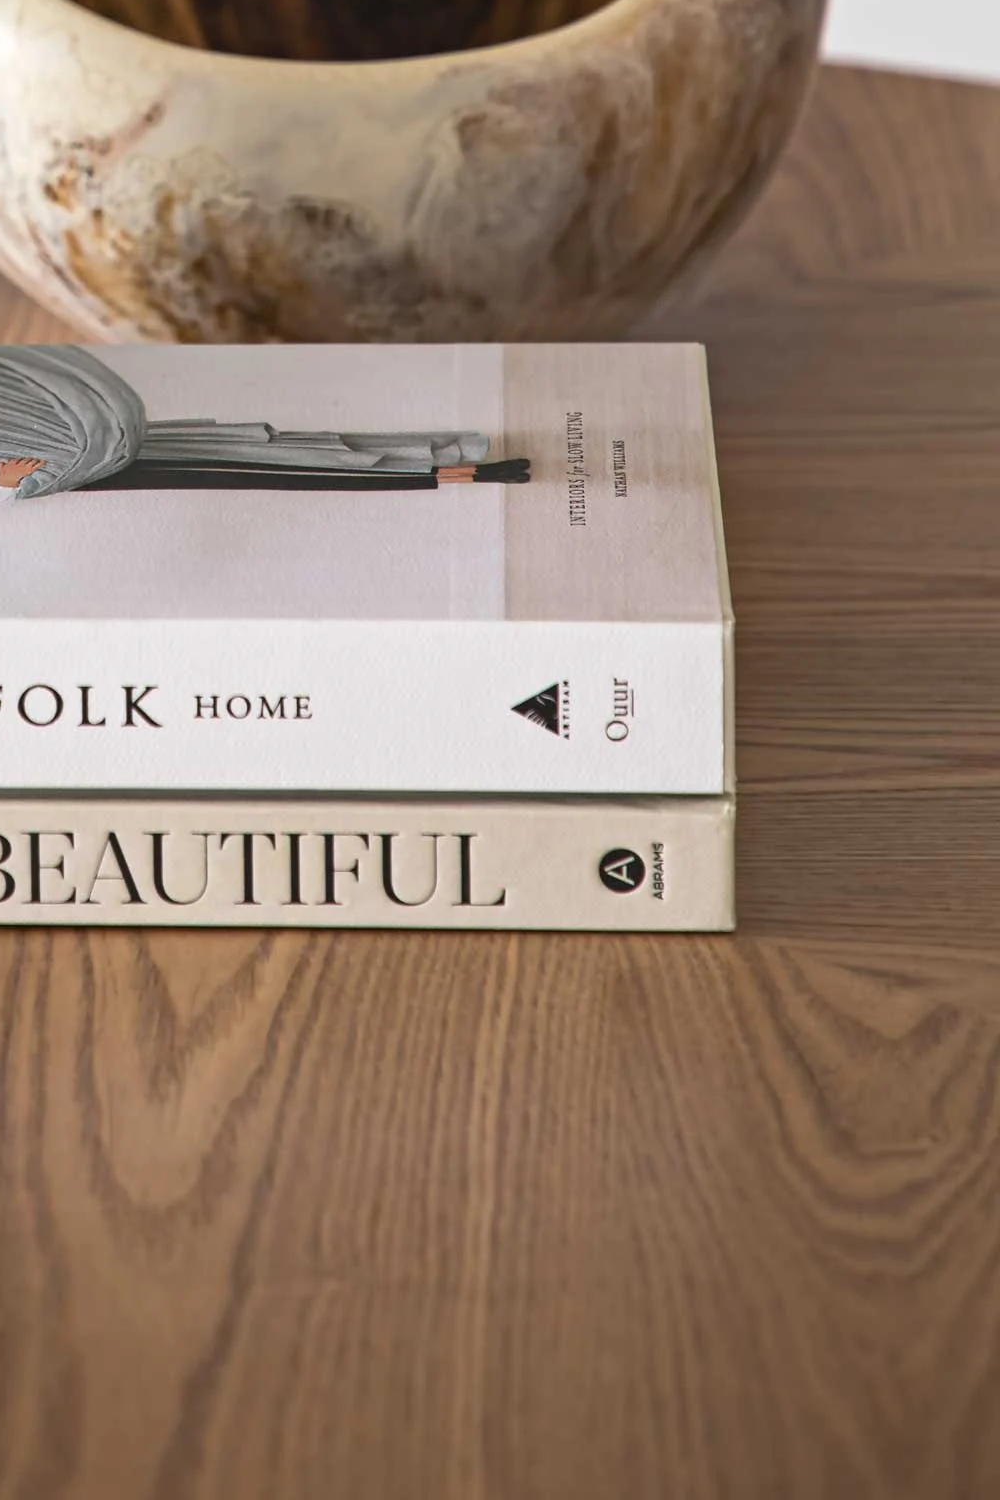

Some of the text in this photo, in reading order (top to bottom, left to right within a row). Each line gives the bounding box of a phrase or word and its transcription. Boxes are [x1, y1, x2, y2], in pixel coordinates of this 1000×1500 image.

[566, 411, 590, 526] INTERIORS for SLOW LIVING
[612, 440, 627, 498] NATHAN WILLIAMS
[193, 694, 313, 721] HOME
[562, 679, 570, 740] ARTISAN
[604, 677, 630, 743] Ouur
[652, 841, 665, 901] ABRAMS
